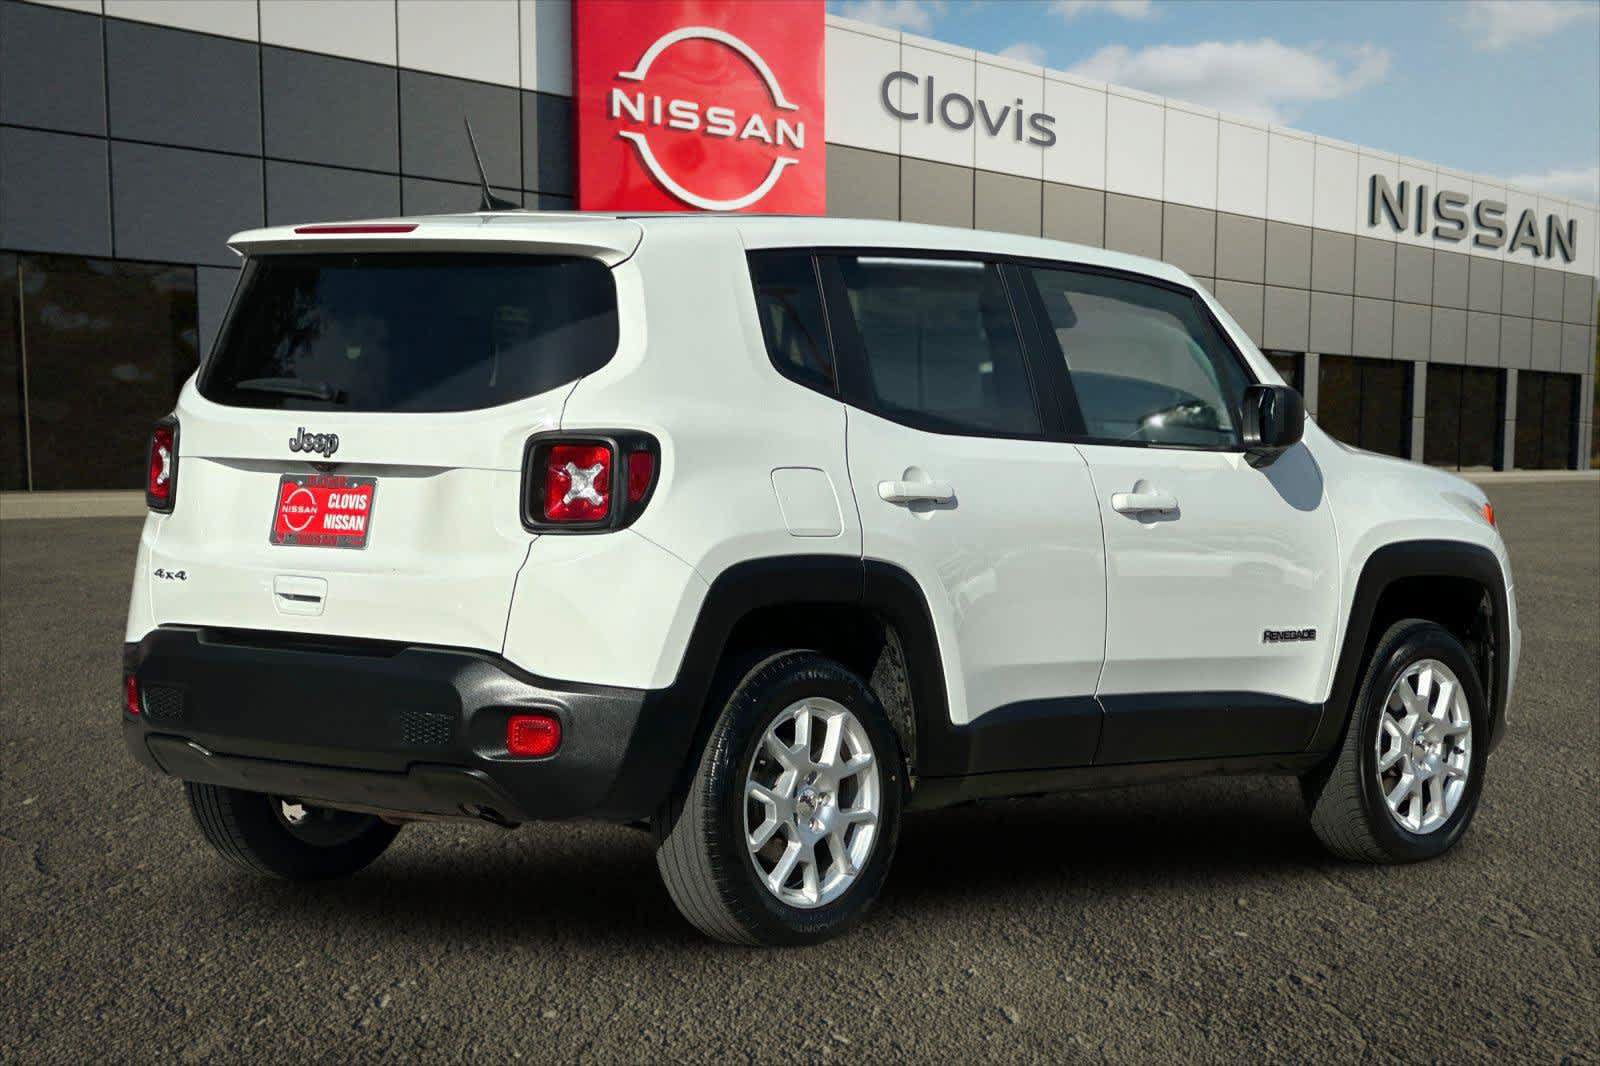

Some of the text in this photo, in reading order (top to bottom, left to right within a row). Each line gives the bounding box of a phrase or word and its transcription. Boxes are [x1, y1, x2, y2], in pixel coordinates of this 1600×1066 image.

[881, 71, 1057, 147] Clovis
[612, 88, 805, 149] NISSAN
[1369, 174, 1578, 263] NISSAN
[289, 427, 339, 458] Jeep
[282, 505, 318, 513] NISSAN
[327, 493, 367, 510] CLOVIS
[323, 513, 365, 530] NISSAN
[154, 568, 187, 580] 4x4
[1263, 629, 1316, 643] RENEGADE
